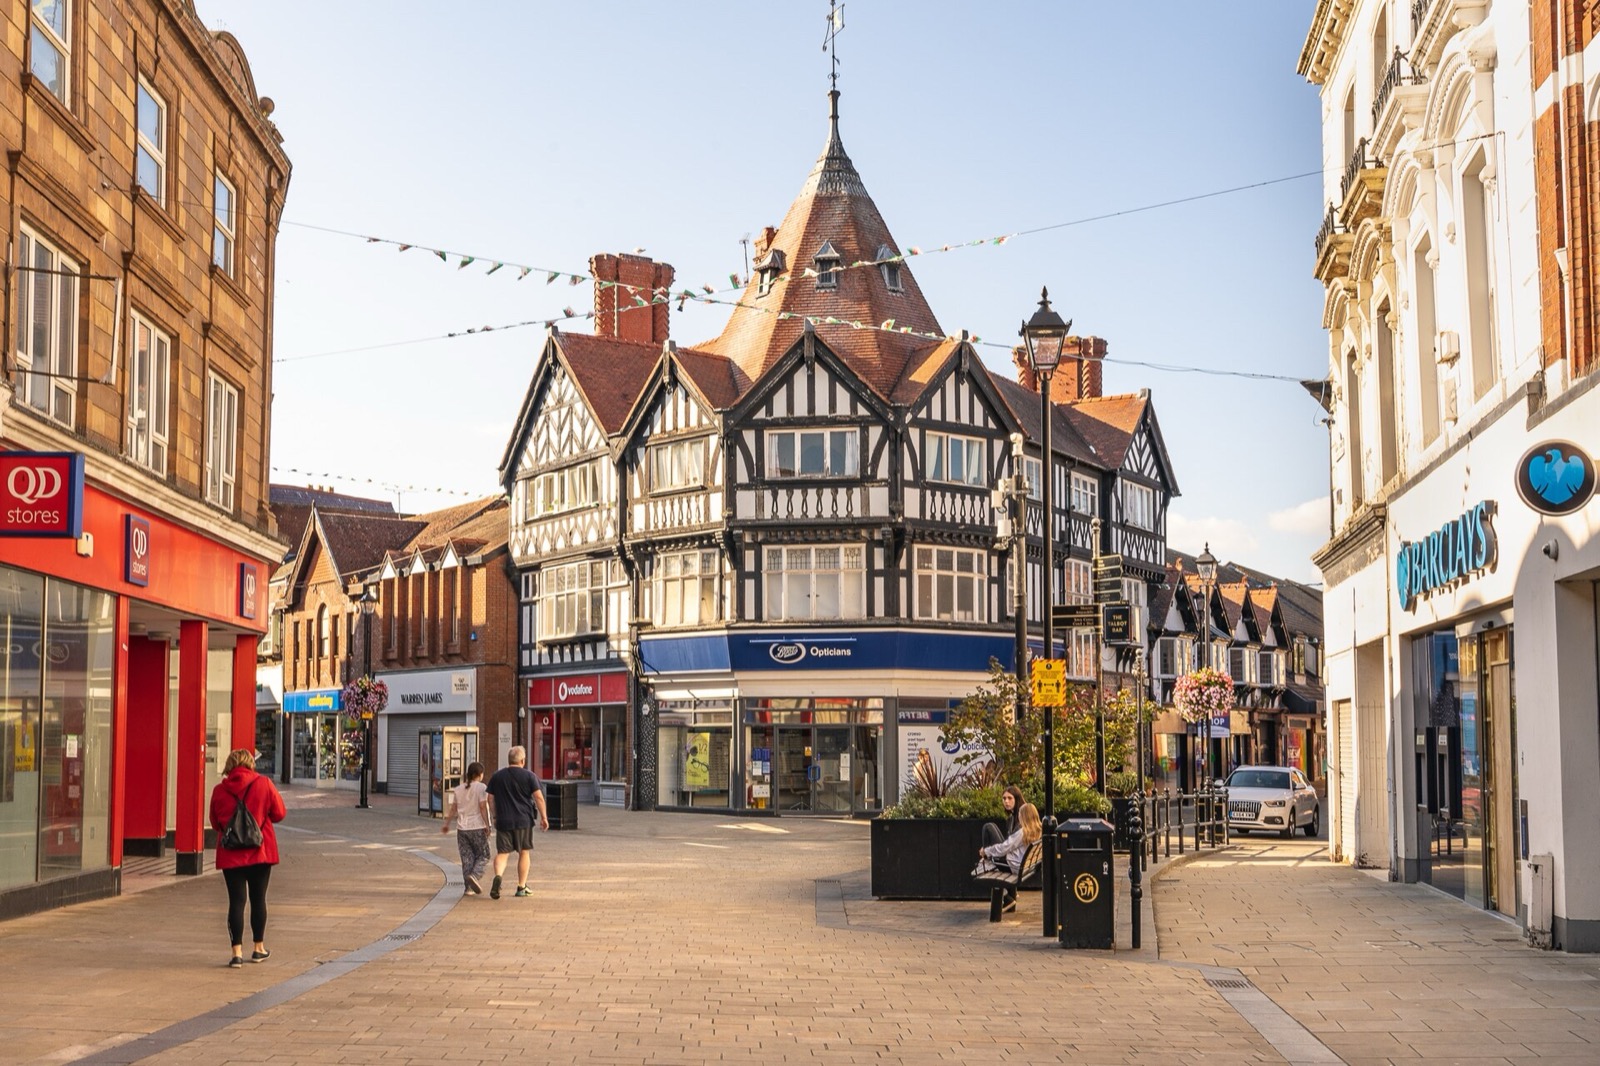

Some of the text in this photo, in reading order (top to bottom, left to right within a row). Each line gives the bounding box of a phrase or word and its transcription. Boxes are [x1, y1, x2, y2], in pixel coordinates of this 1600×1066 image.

[7, 466, 62, 504] QD
[7, 507, 59, 523] stores
[133, 528, 147, 559] QD
[1411, 500, 1487, 597] BARCLAYS
[132, 561, 146, 576] stores
[810, 646, 852, 658] Opticians
[567, 683, 593, 696] vodafone
[401, 692, 443, 705] WARREN JAMES
